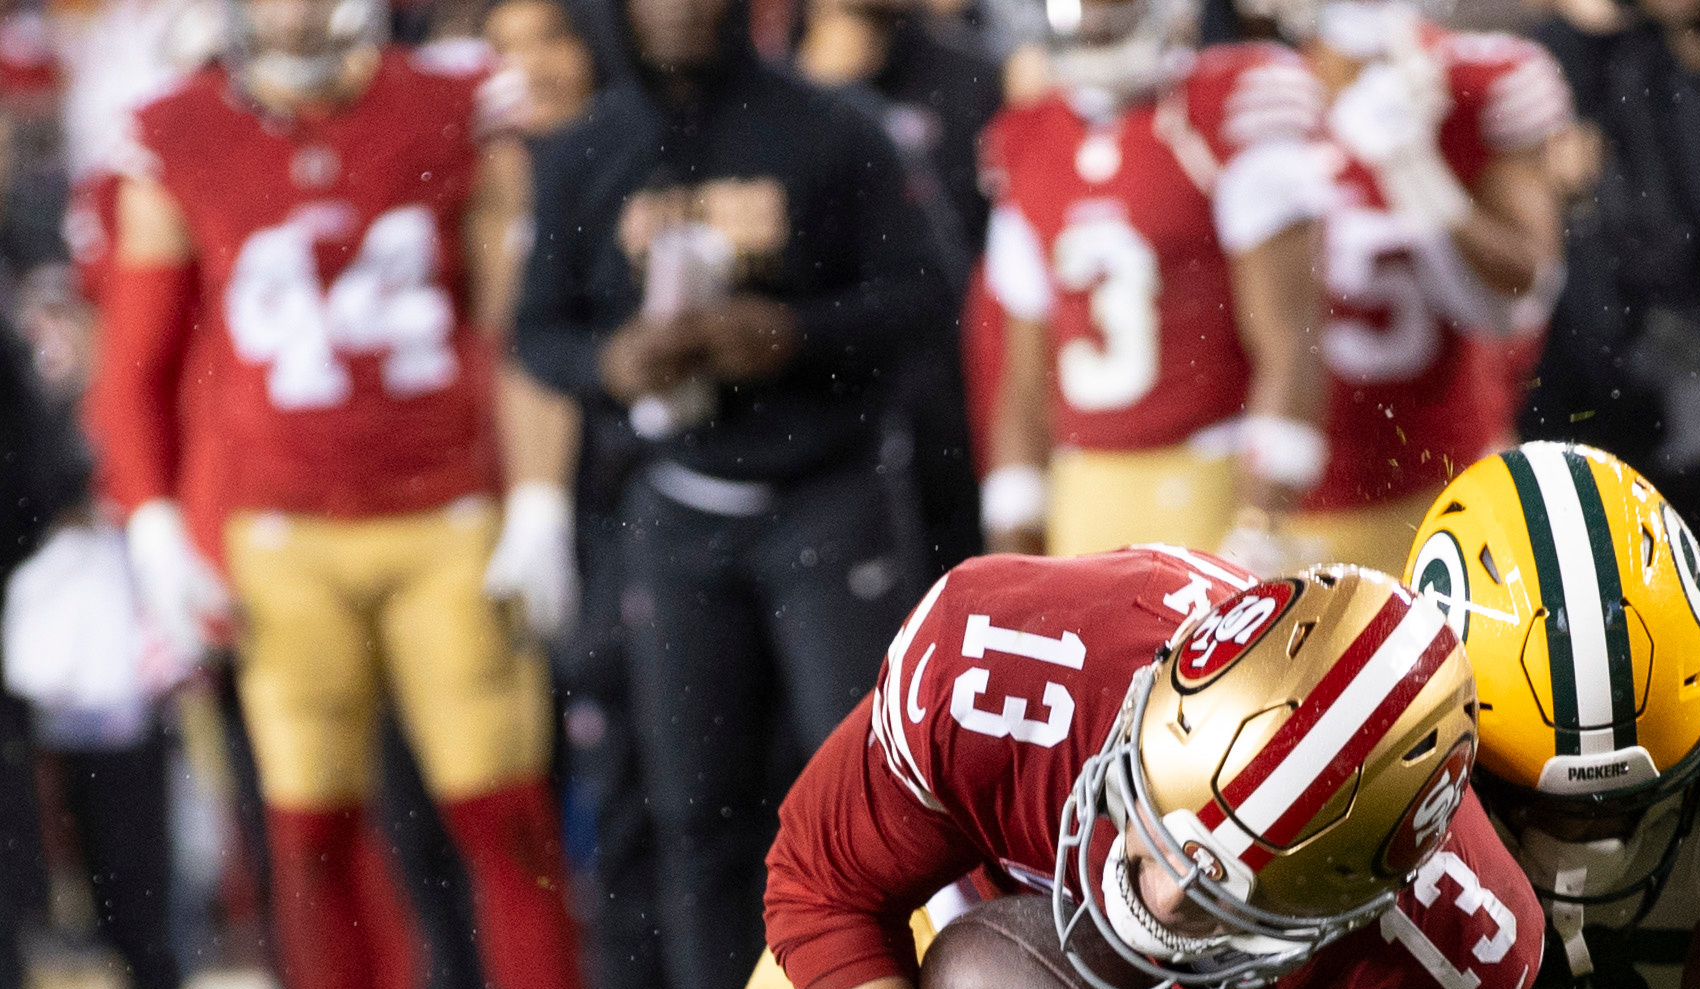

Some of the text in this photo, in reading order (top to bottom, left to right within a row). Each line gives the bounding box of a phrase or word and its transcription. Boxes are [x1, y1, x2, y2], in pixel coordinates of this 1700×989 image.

[228, 207, 459, 408] 44
[1056, 204, 1160, 411] 3
[950, 613, 1087, 749] 13
[1568, 761, 1629, 781] PACKERS
